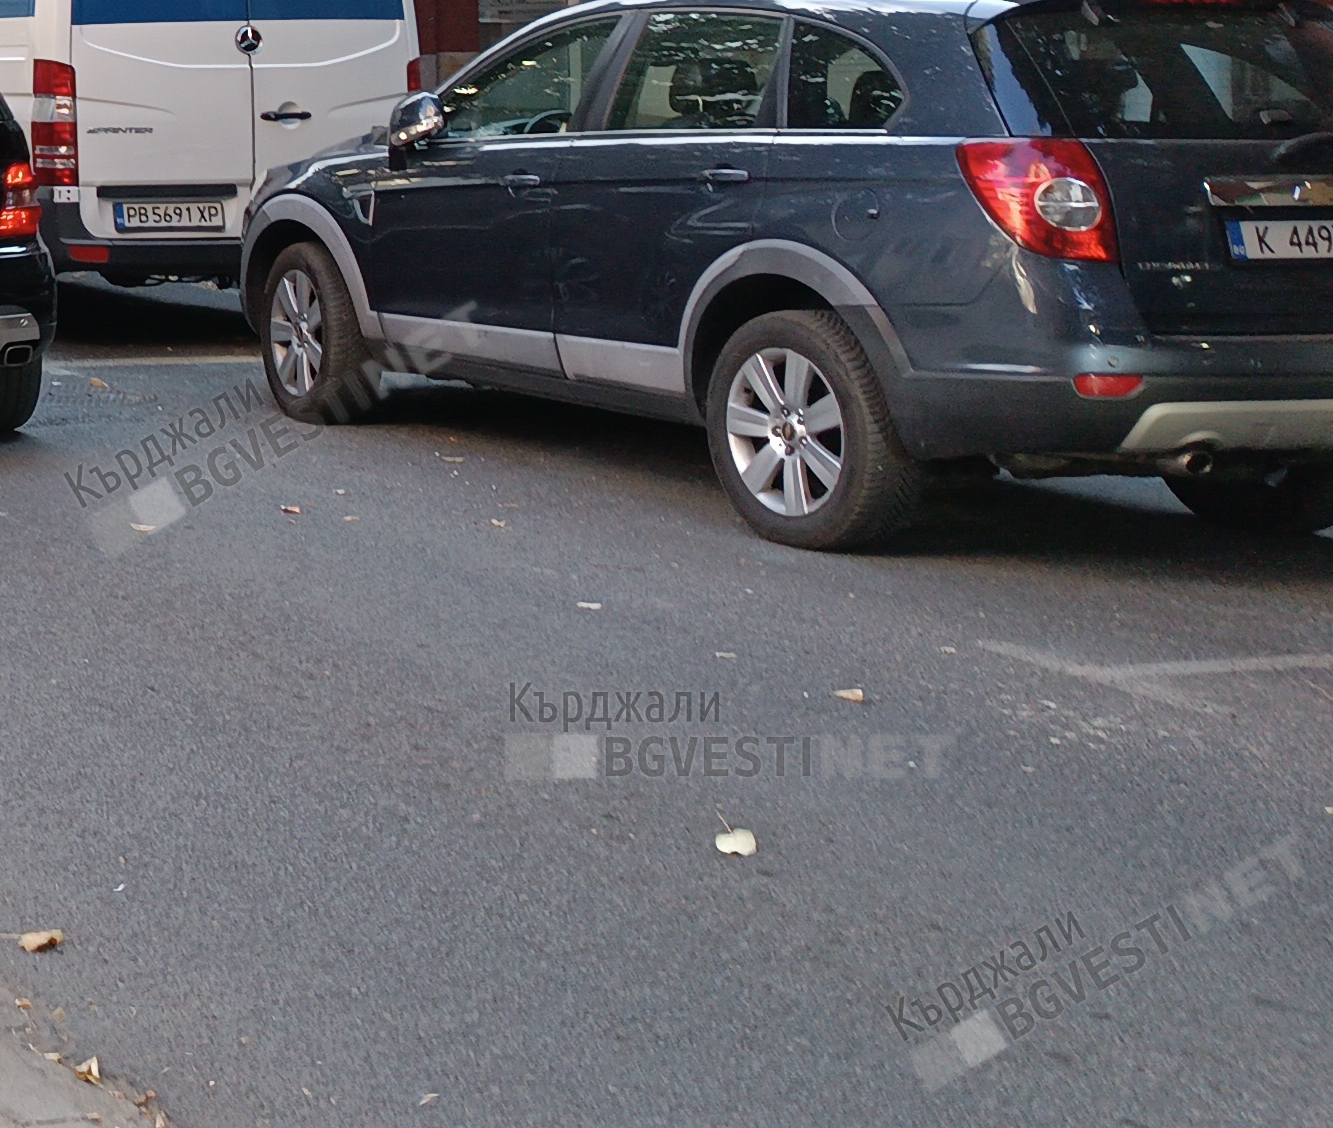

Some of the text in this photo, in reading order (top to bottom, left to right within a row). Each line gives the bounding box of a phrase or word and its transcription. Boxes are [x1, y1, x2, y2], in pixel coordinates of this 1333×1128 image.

[152, 206, 192, 224] 5691
[1255, 224, 1333, 254] K 449
